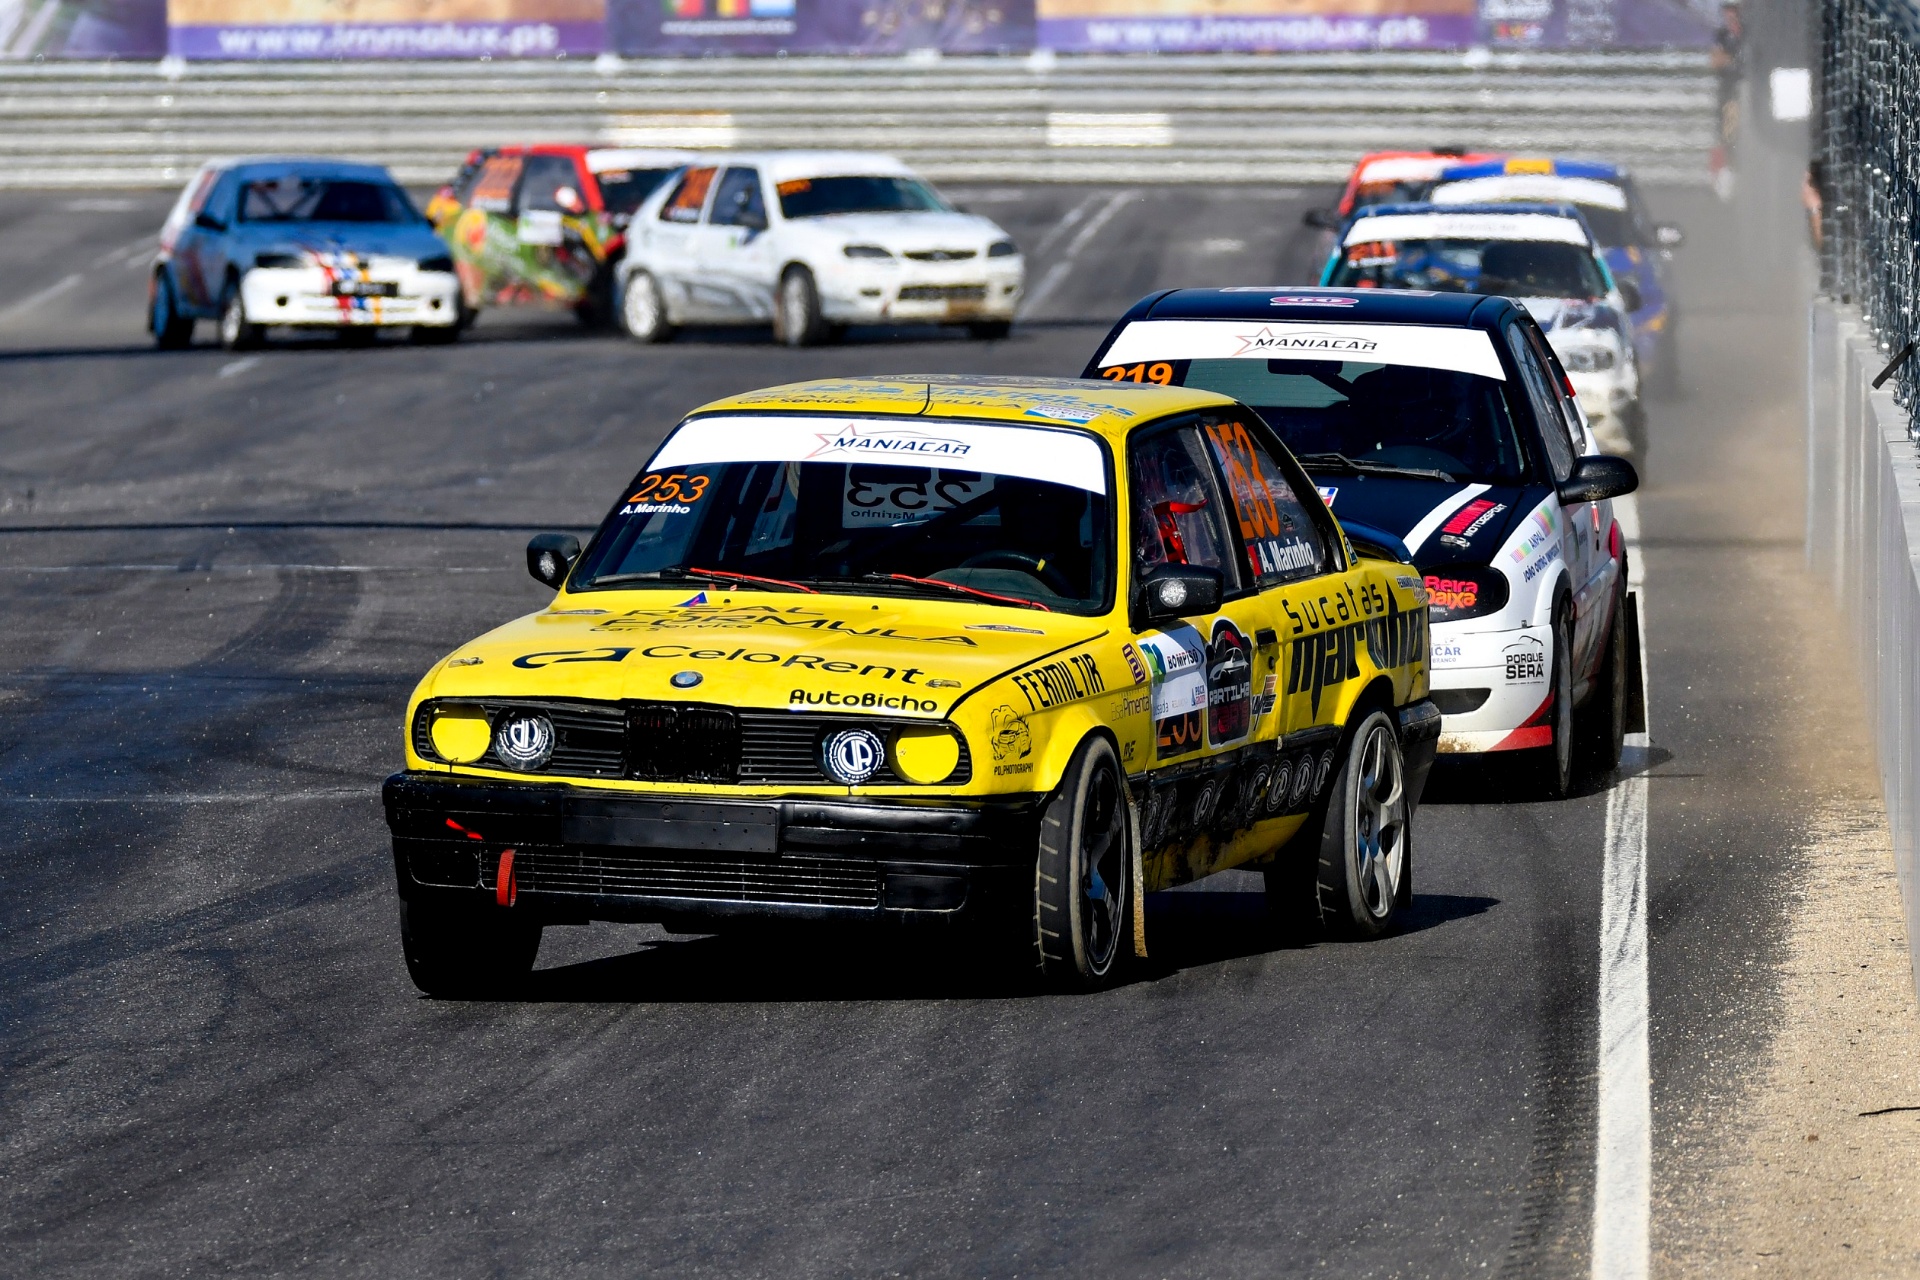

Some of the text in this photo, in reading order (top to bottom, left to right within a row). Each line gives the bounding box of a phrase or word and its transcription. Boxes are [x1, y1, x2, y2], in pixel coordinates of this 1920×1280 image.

[1255, 338, 1378, 351] MANIACAR
[1102, 362, 1173, 386] 219
[833, 437, 972, 456] MANIACAR
[627, 474, 710, 503] 253
[1205, 422, 1280, 539] 253
[618, 502, 691, 516] A.Marinho
[1258, 541, 1275, 573] A.
[1268, 536, 1315, 572] Marinho
[1424, 575, 1478, 593] Beira
[1282, 582, 1384, 634] Sucatas
[600, 615, 979, 647] FORMULA
[641, 645, 925, 685] CeloRent
[1011, 660, 1084, 712] FERMIL
[1070, 653, 1106, 696] TIR
